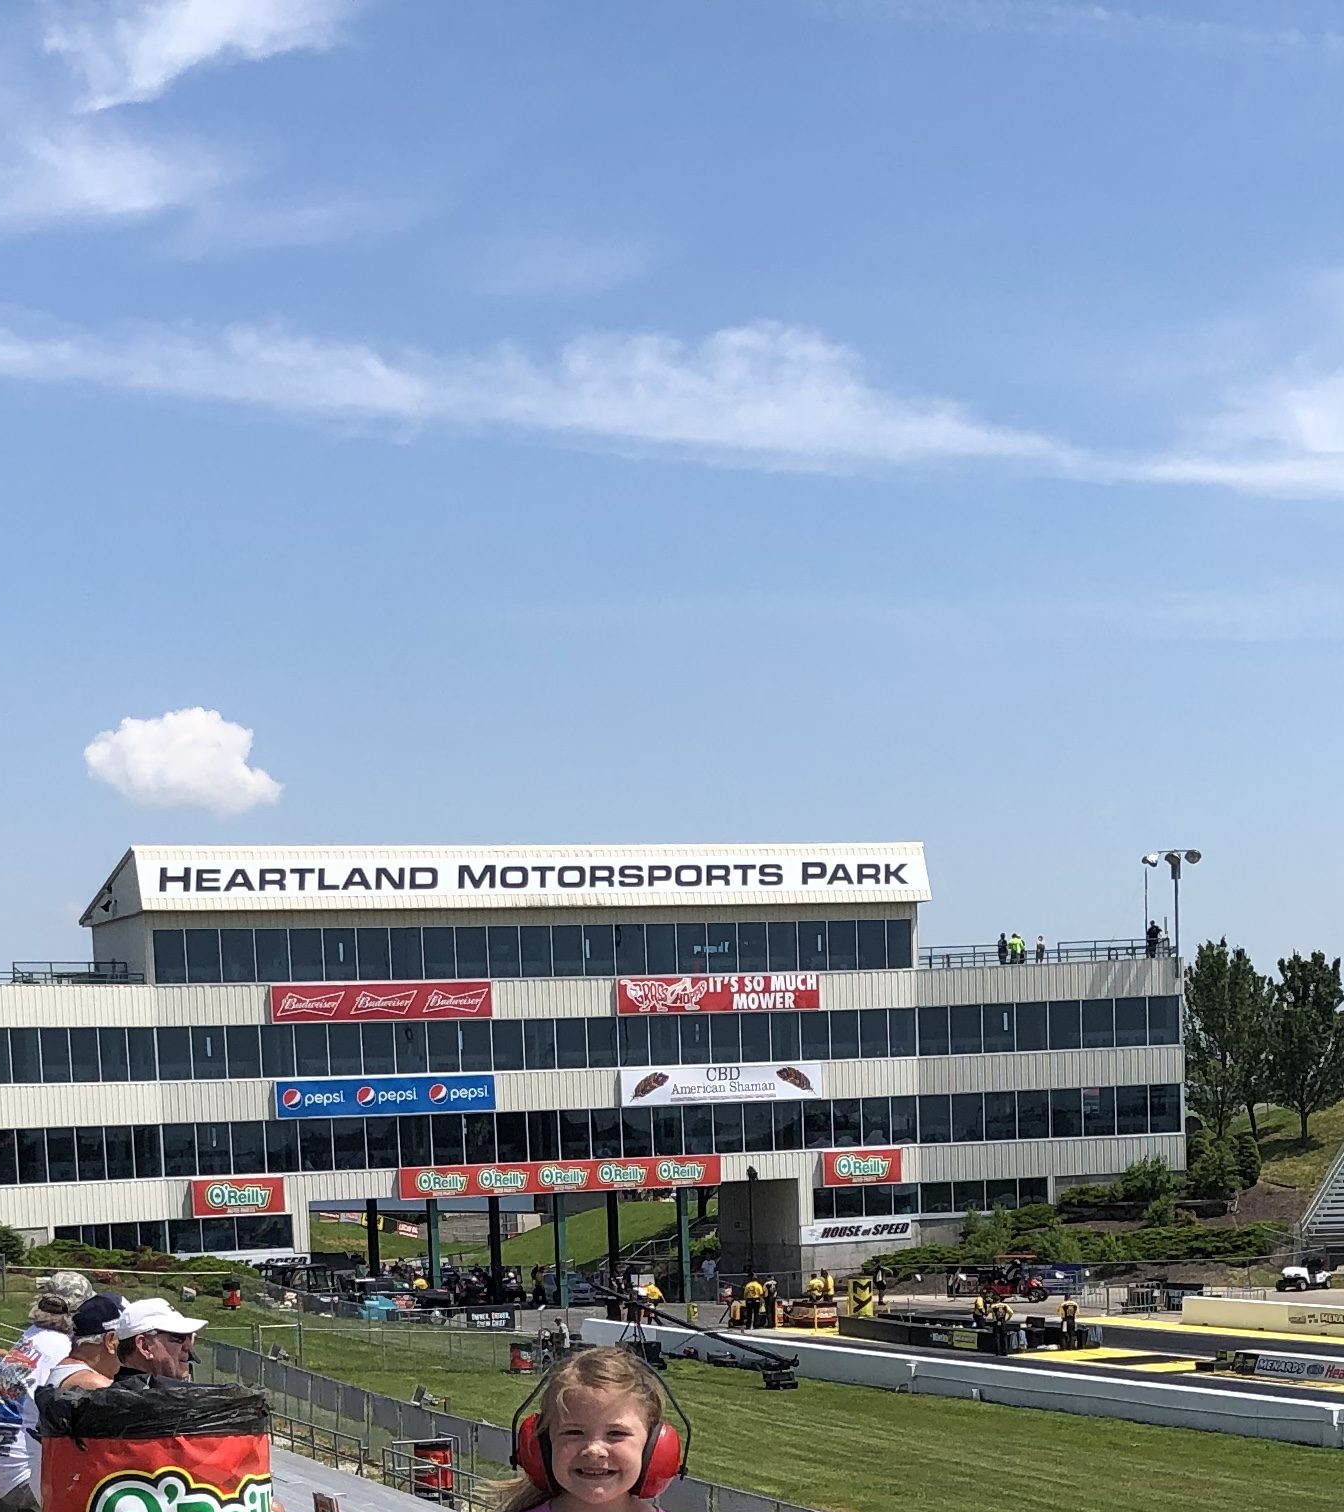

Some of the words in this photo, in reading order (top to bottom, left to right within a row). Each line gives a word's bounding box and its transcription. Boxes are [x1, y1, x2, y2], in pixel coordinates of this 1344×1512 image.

[159, 866, 438, 892] HEARTLAND
[458, 863, 783, 889] MOTORSPORTS
[801, 861, 909, 886] PARK
[708, 976, 738, 993] IT'S
[744, 976, 765, 992] SO
[770, 974, 817, 991] MUCH
[281, 995, 339, 1010] Budweiser
[354, 993, 411, 1009] Budweiser
[427, 992, 482, 1008] Budweiser
[732, 991, 796, 1010] MOWER
[706, 1066, 741, 1082] CBD
[378, 1086, 418, 1104] pepsi
[450, 1084, 489, 1101] pepsi
[671, 1082, 726, 1096] American
[729, 1081, 776, 1093] Shaman
[304, 1089, 345, 1107] pepsi
[599, 1163, 647, 1185] O'Reilly
[658, 1160, 706, 1182] O'Reilly
[836, 1155, 889, 1176] O'Reilly
[418, 1171, 467, 1192] O'Reilly
[479, 1168, 527, 1190] O'Reilly
[540, 1165, 588, 1187] O'Reilly
[209, 1184, 270, 1207] O'Reilly
[820, 1226, 861, 1239] HOUSE
[872, 1222, 910, 1236] SPEED
[1256, 1357, 1306, 1375] MENARDS
